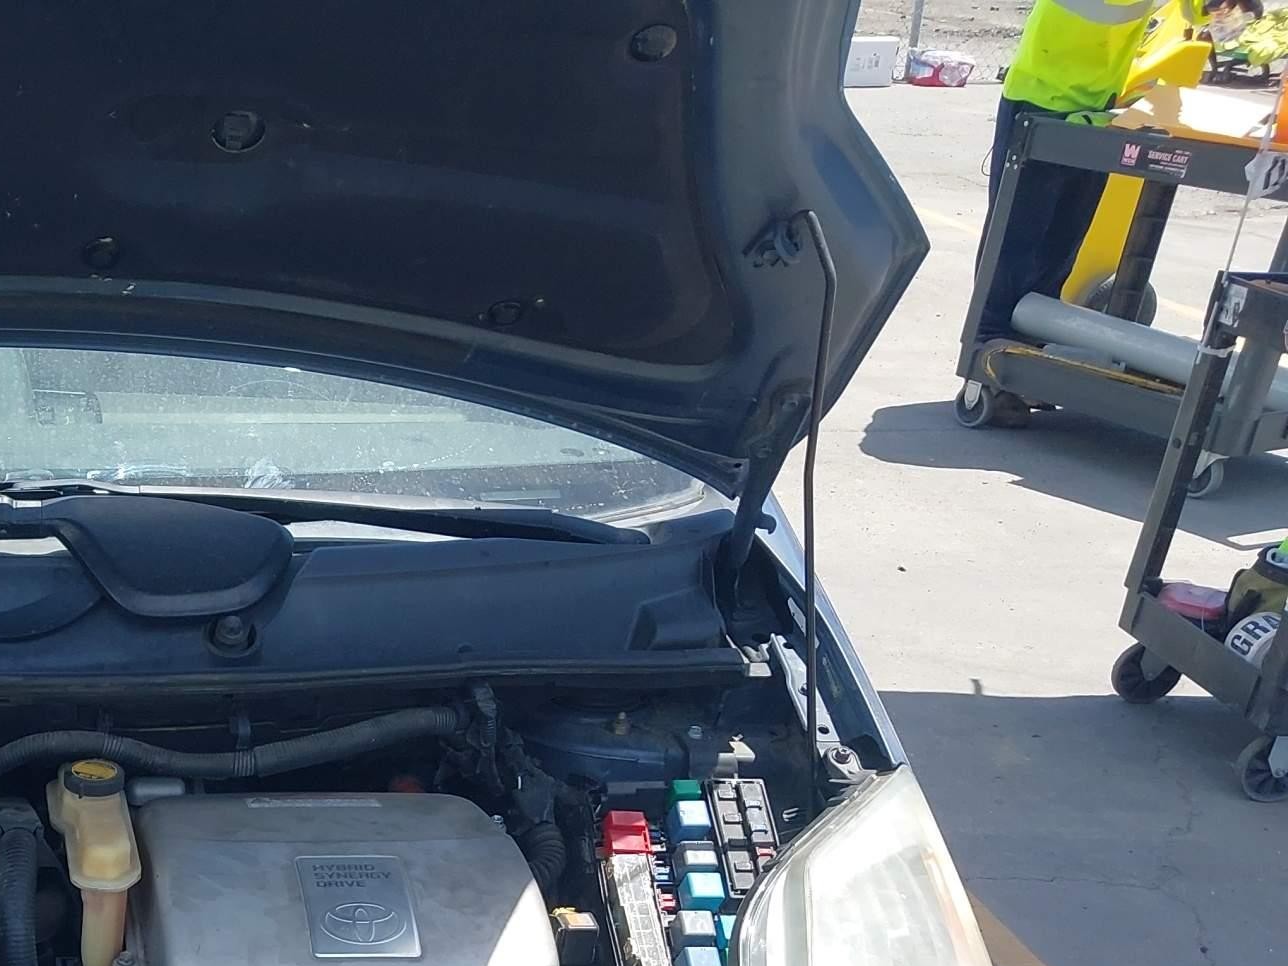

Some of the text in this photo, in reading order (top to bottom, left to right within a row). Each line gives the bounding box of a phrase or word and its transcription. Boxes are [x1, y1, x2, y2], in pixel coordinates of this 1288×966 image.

[1172, 155, 1189, 164] CART
[313, 864, 375, 872] HYBRID
[313, 872, 391, 880] SYNERGY
[316, 880, 367, 888] DRIVE
